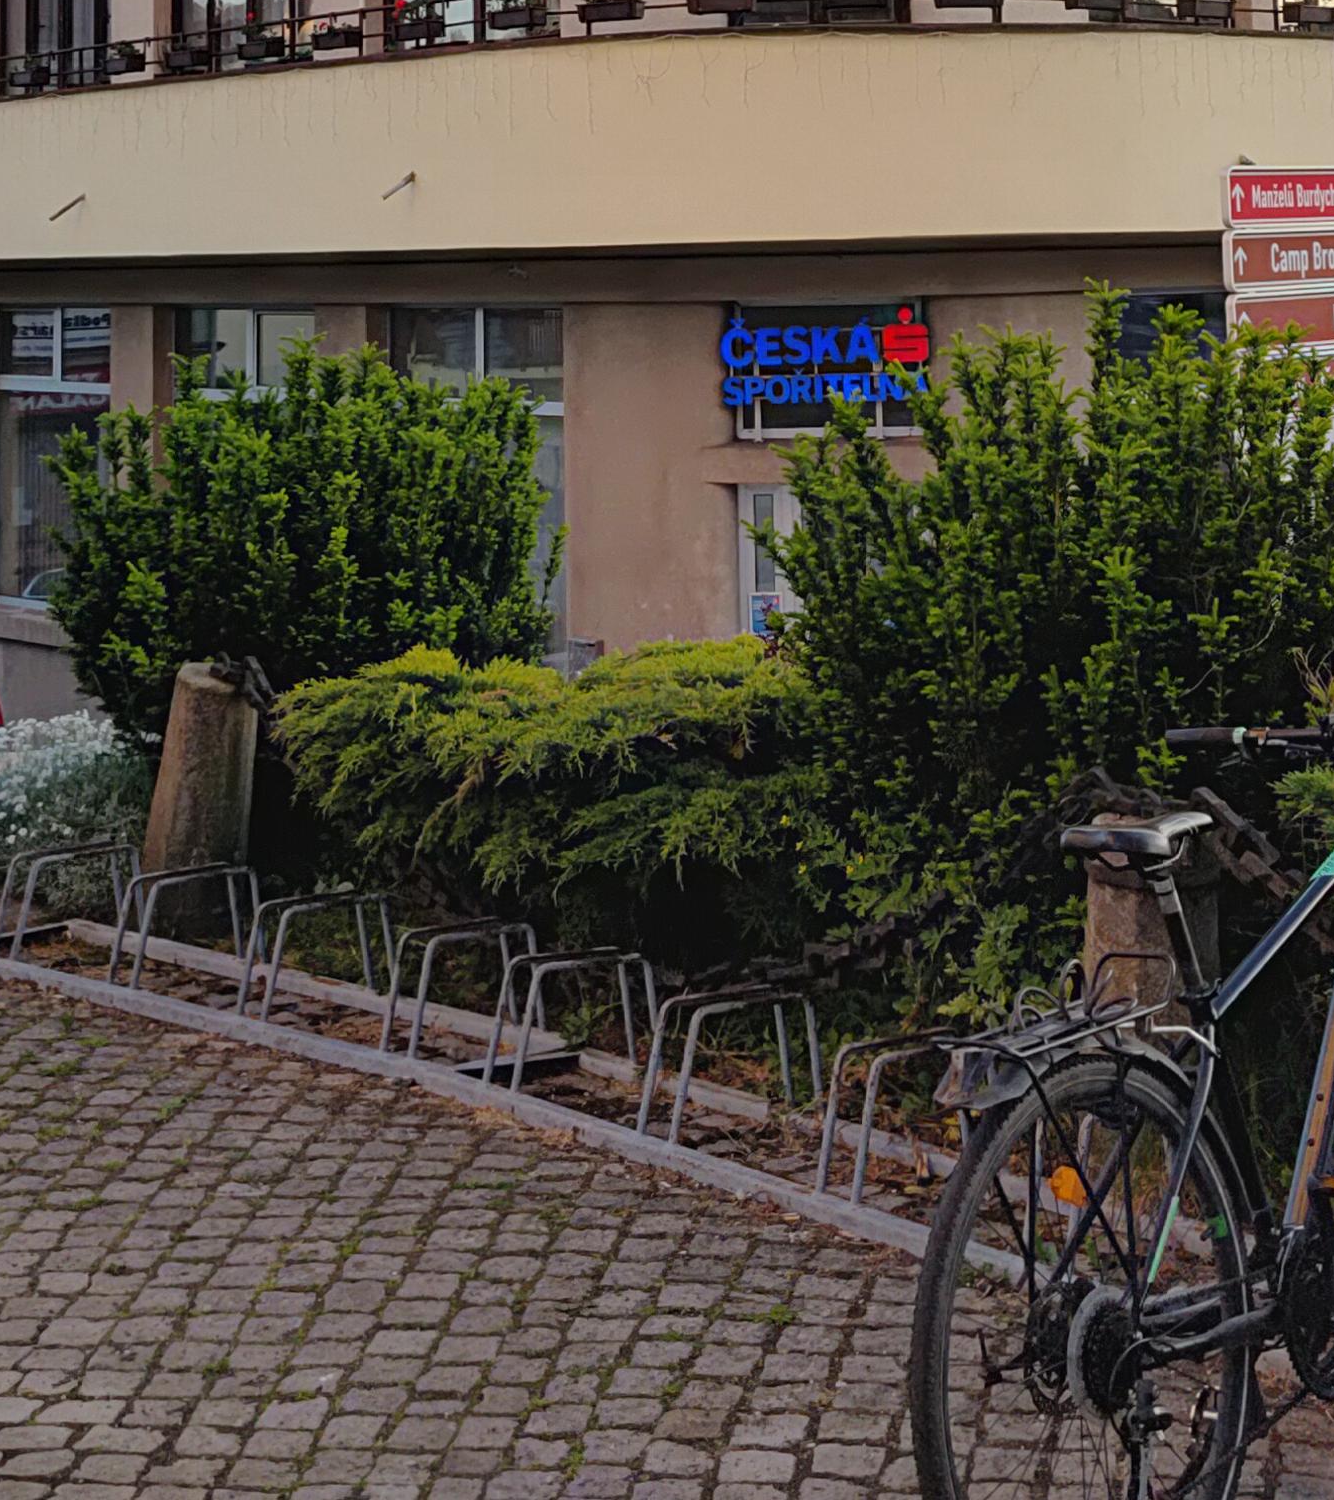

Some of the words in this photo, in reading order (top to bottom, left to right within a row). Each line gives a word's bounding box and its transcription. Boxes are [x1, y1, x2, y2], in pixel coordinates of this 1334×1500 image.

[1251, 182, 1294, 209] Manželů
[1270, 243, 1309, 278] Camp
[720, 316, 881, 368] ČESKÁ
